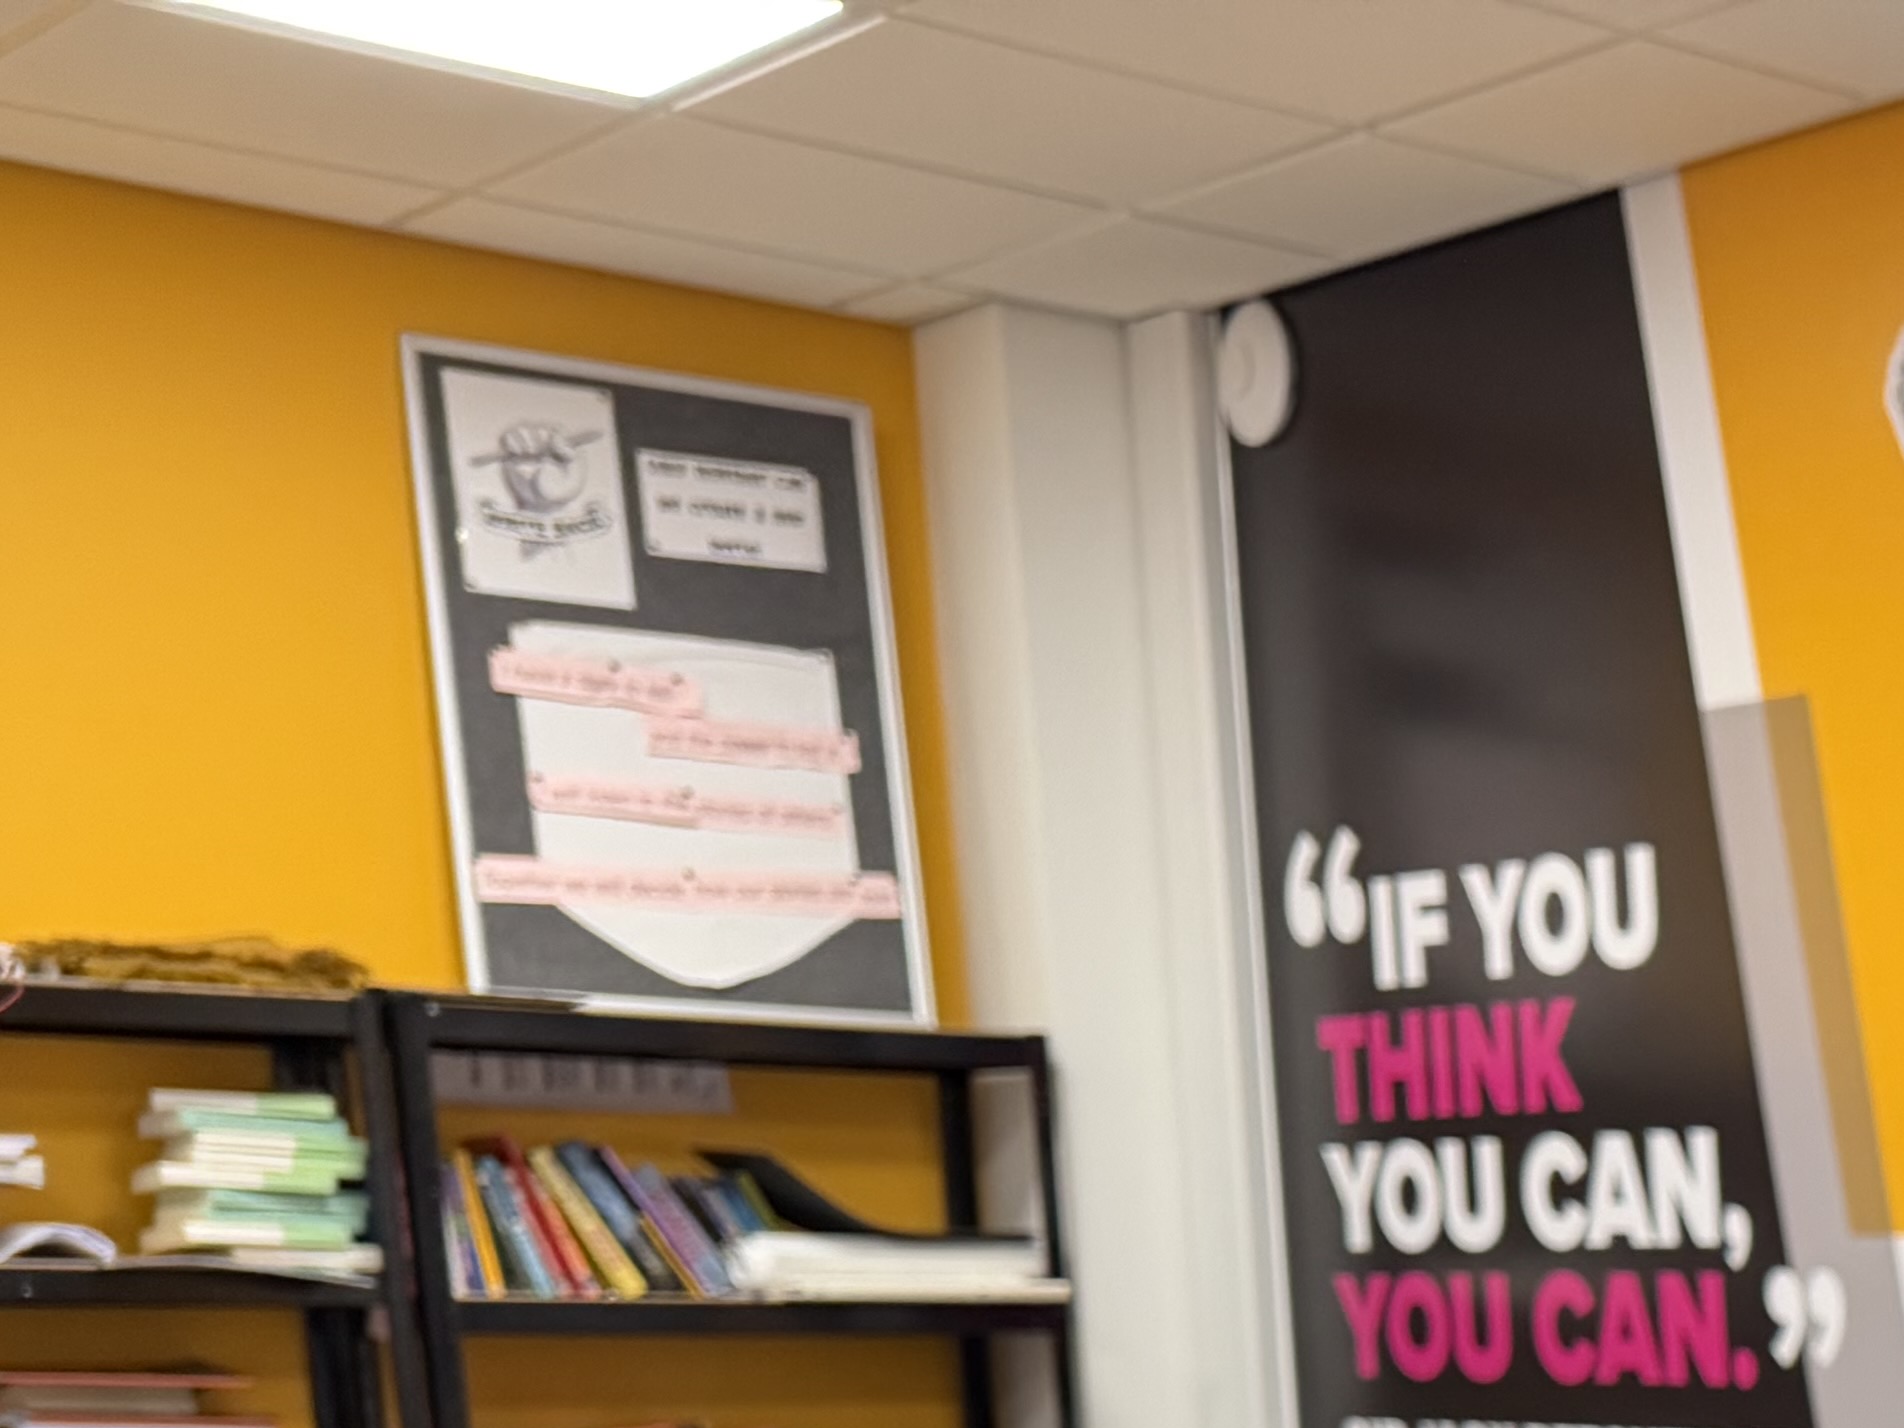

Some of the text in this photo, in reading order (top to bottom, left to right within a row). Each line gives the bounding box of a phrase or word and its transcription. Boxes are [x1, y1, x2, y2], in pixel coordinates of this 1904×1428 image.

[1459, 842, 1660, 980] YOU
[1316, 997, 1584, 1125] THINK
[1319, 1126, 1753, 1271] YOU CAN,
[1334, 1269, 1513, 1384] YOU
